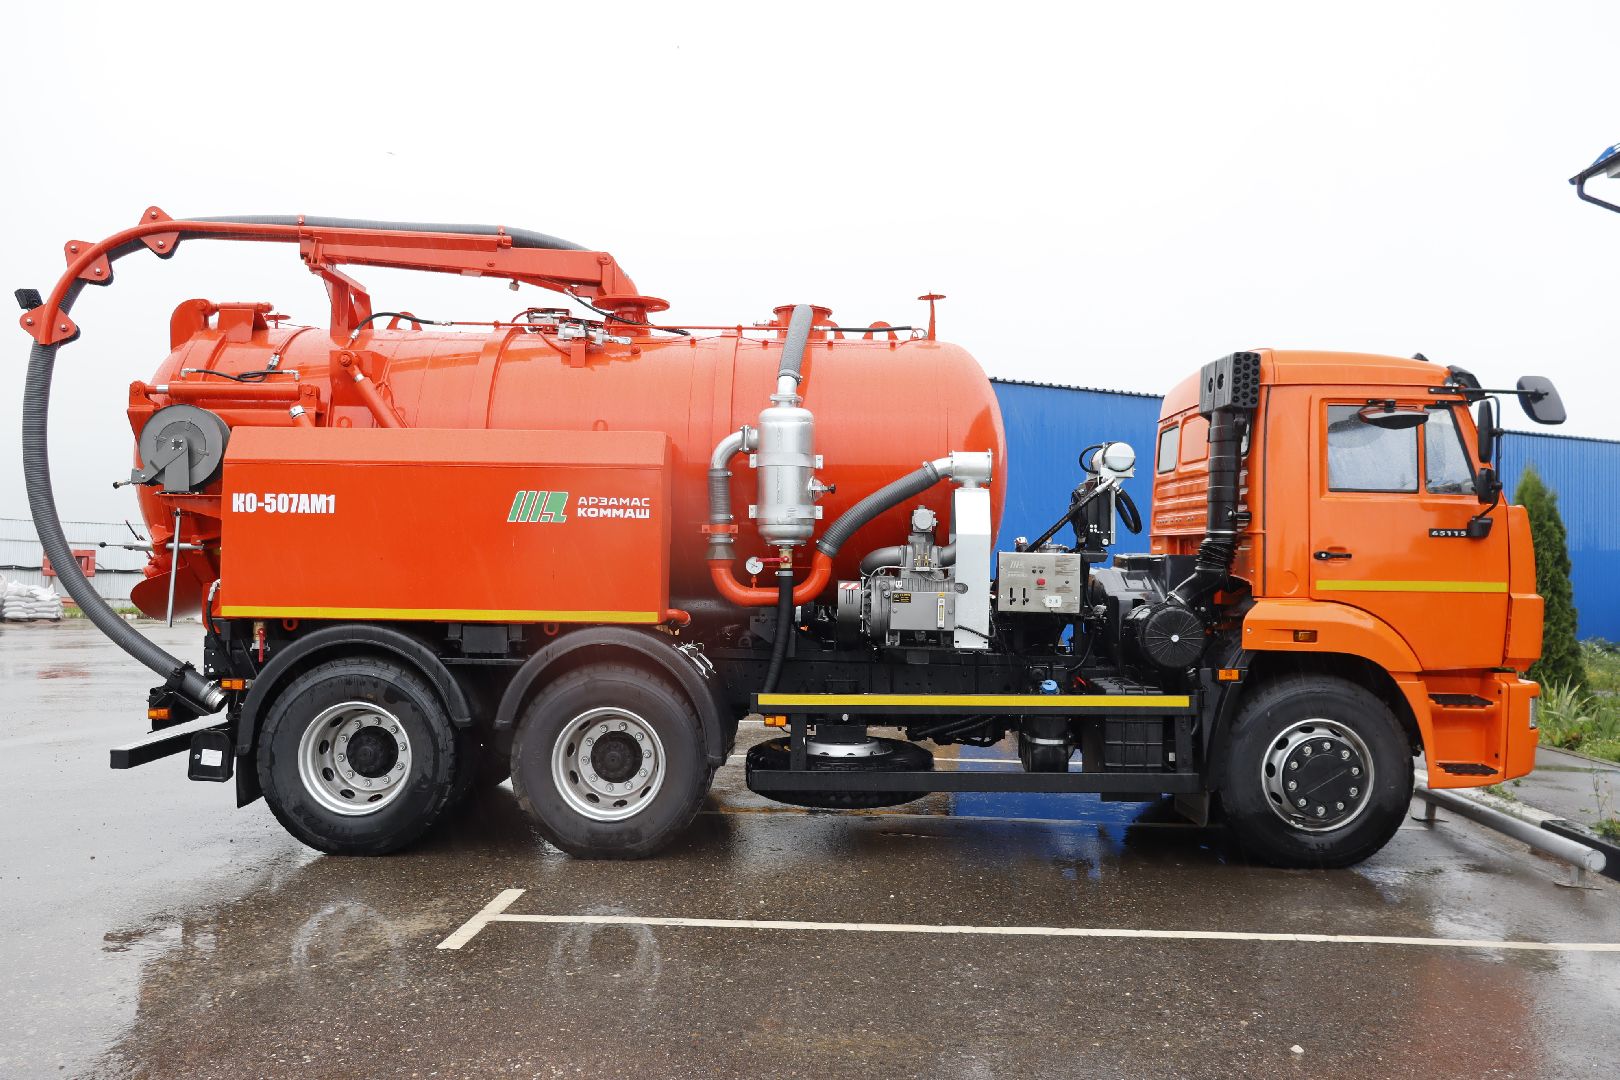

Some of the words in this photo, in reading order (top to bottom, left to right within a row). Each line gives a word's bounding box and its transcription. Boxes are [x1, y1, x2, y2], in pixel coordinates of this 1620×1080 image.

[232, 492, 336, 514] КО-507АМ1
[577, 496, 650, 507] АРЗАМАС
[577, 507, 650, 519] КОММАШ
